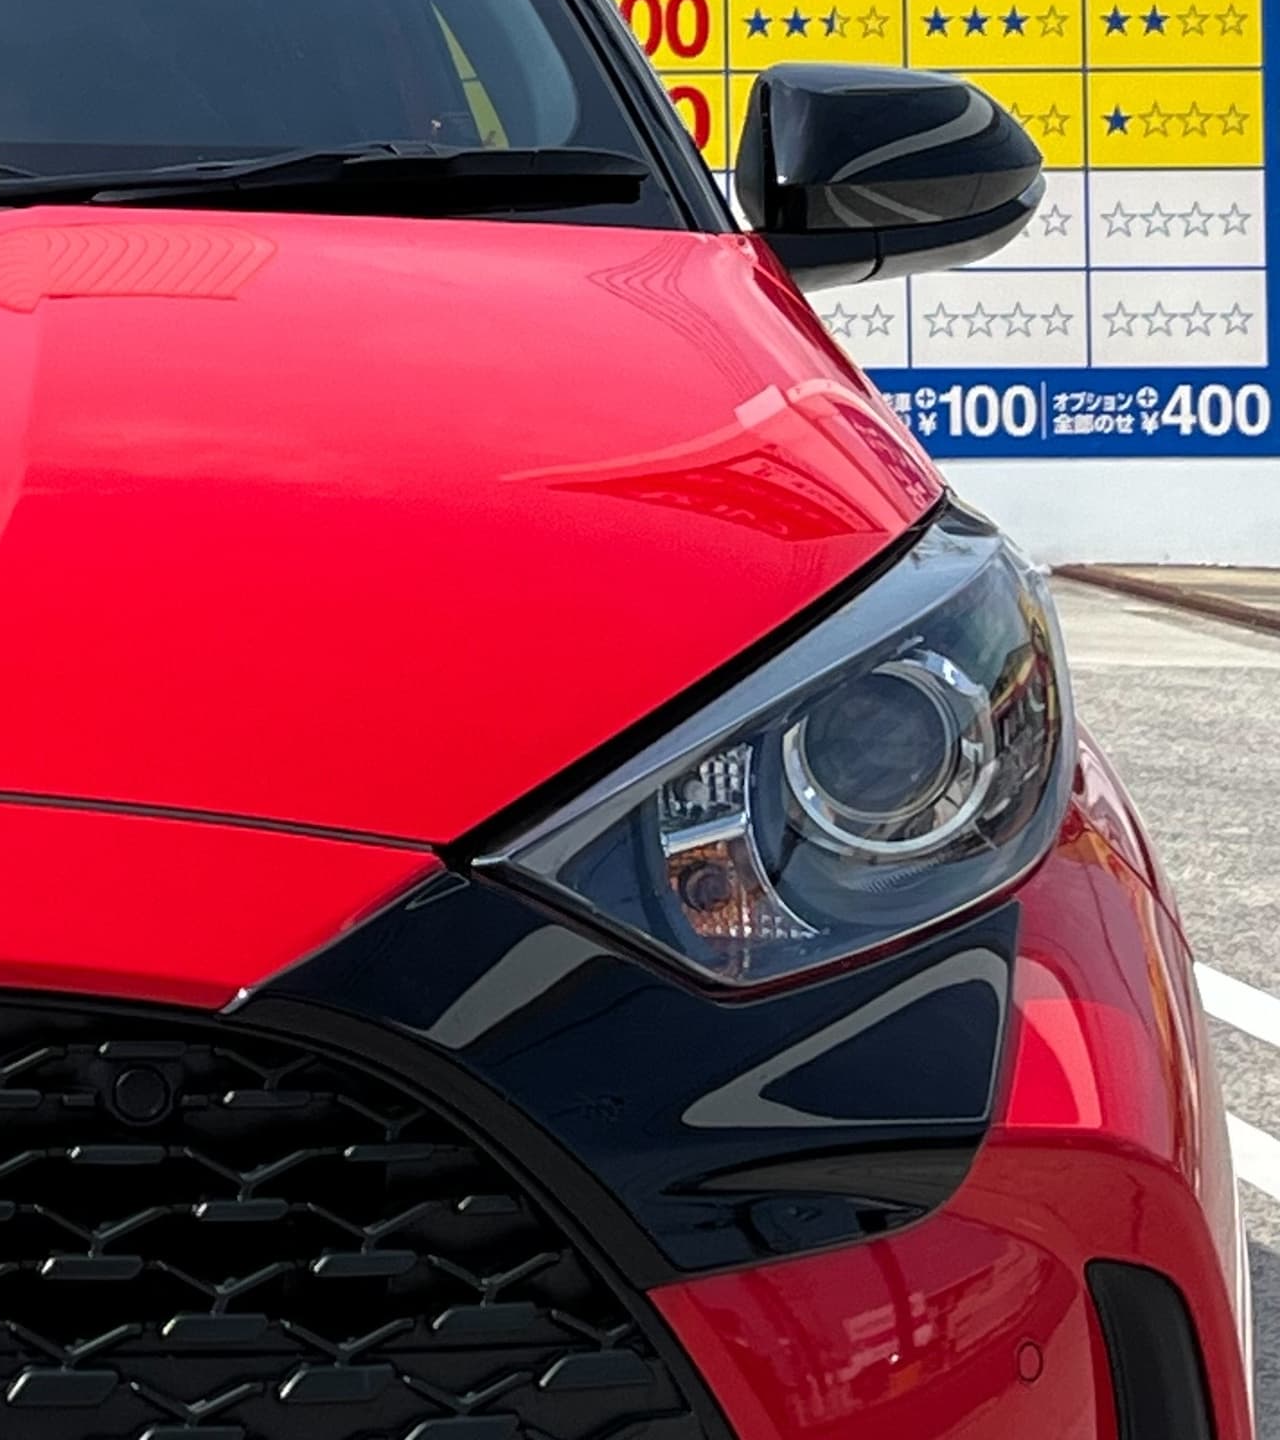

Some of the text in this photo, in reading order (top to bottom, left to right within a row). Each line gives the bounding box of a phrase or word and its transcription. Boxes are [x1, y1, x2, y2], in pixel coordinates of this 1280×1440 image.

[1052, 391, 1134, 412] オプション
[1052, 413, 1135, 435] 全部のせ
